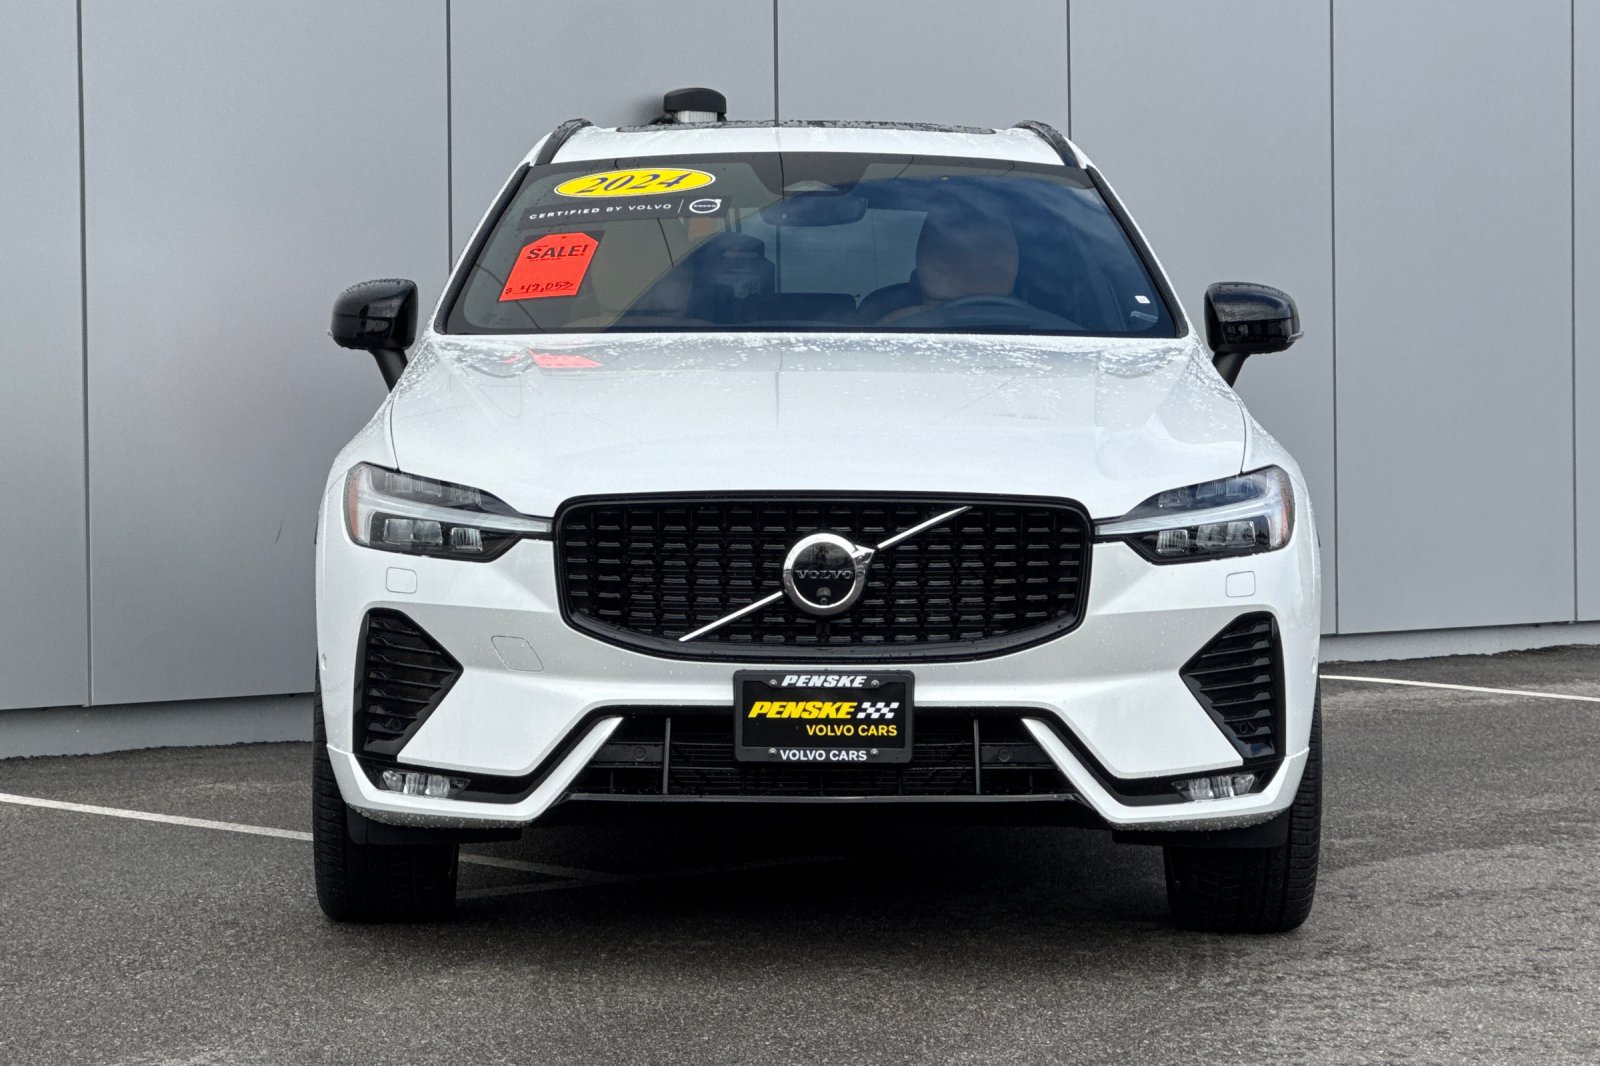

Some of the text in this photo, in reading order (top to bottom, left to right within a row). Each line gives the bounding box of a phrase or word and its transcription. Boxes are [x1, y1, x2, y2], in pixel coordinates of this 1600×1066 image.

[574, 172, 693, 194] 2024
[529, 203, 672, 220] CERTIFIED BY VOLVO
[526, 244, 589, 260] SALE!
[794, 569, 854, 580] VOLVO
[781, 674, 868, 688] PENSKE
[747, 701, 858, 719] PENSKE
[806, 724, 898, 737] VOLVO CARS
[779, 749, 867, 761] VOLVO CARS
